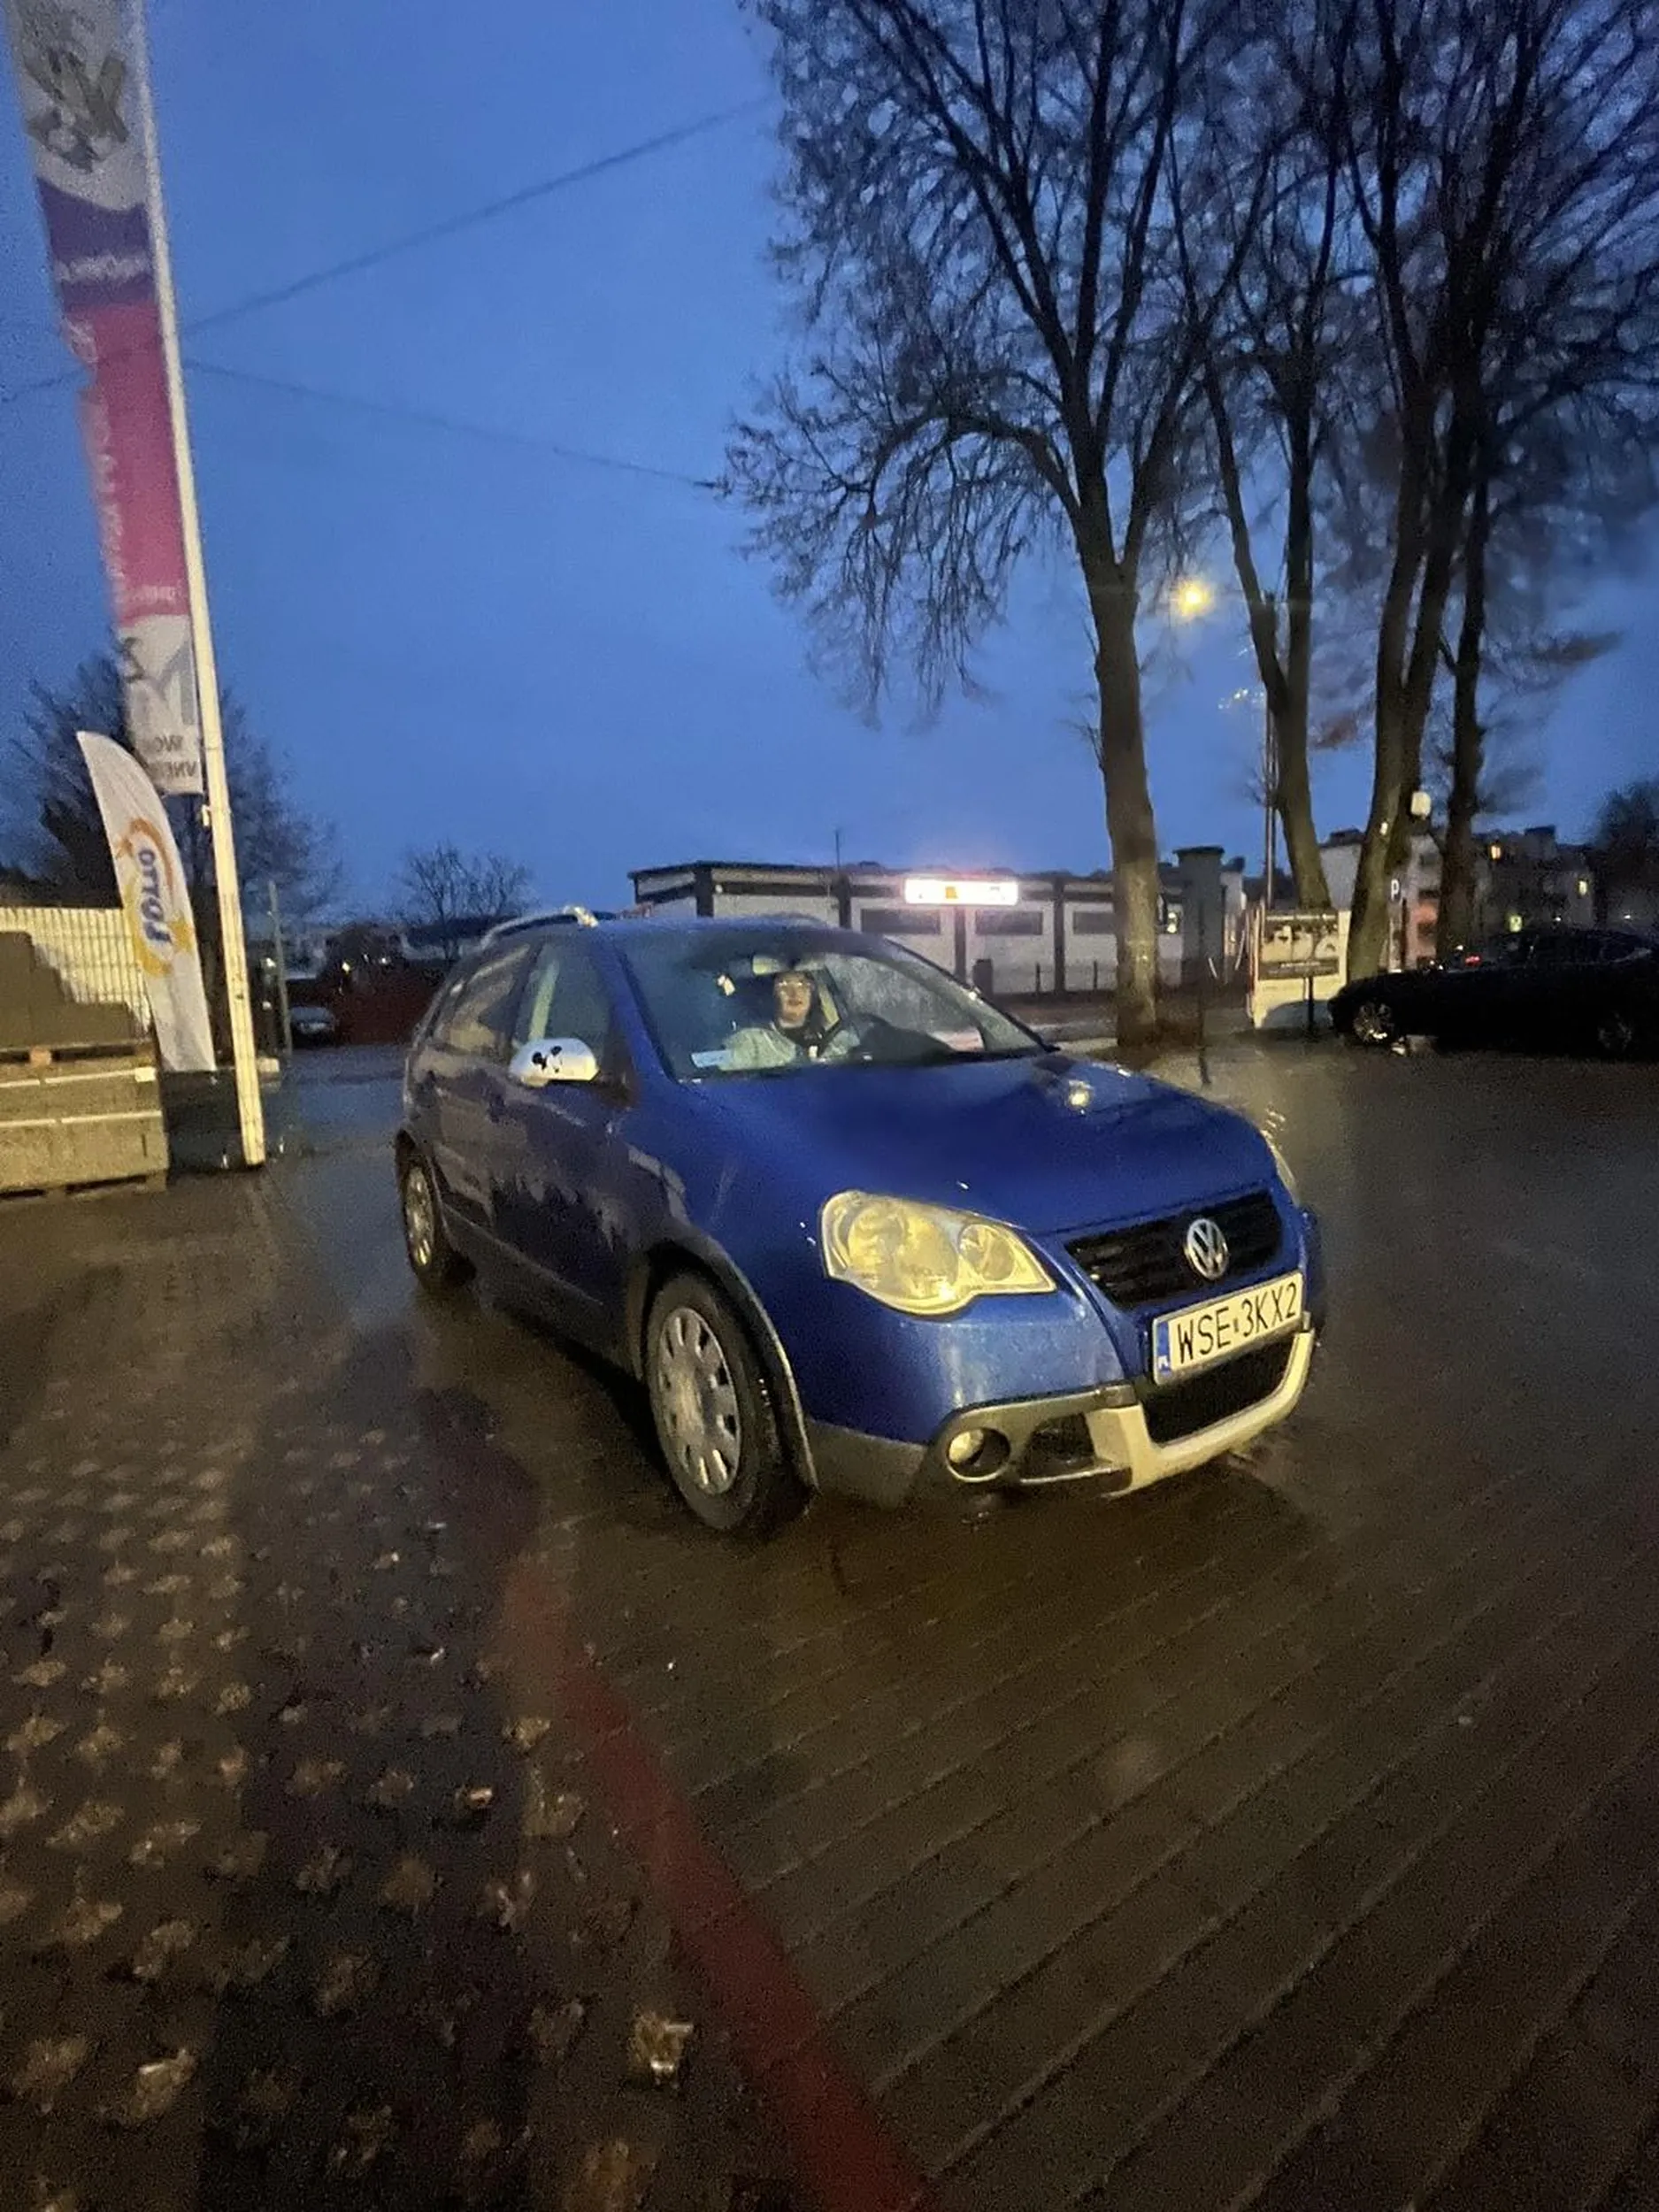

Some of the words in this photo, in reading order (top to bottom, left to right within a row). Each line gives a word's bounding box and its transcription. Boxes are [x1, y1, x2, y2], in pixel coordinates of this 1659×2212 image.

[1391, 879, 1400, 901] P
[1178, 1306, 1231, 1364] WSE
[1241, 1282, 1296, 1337] 3KX2
